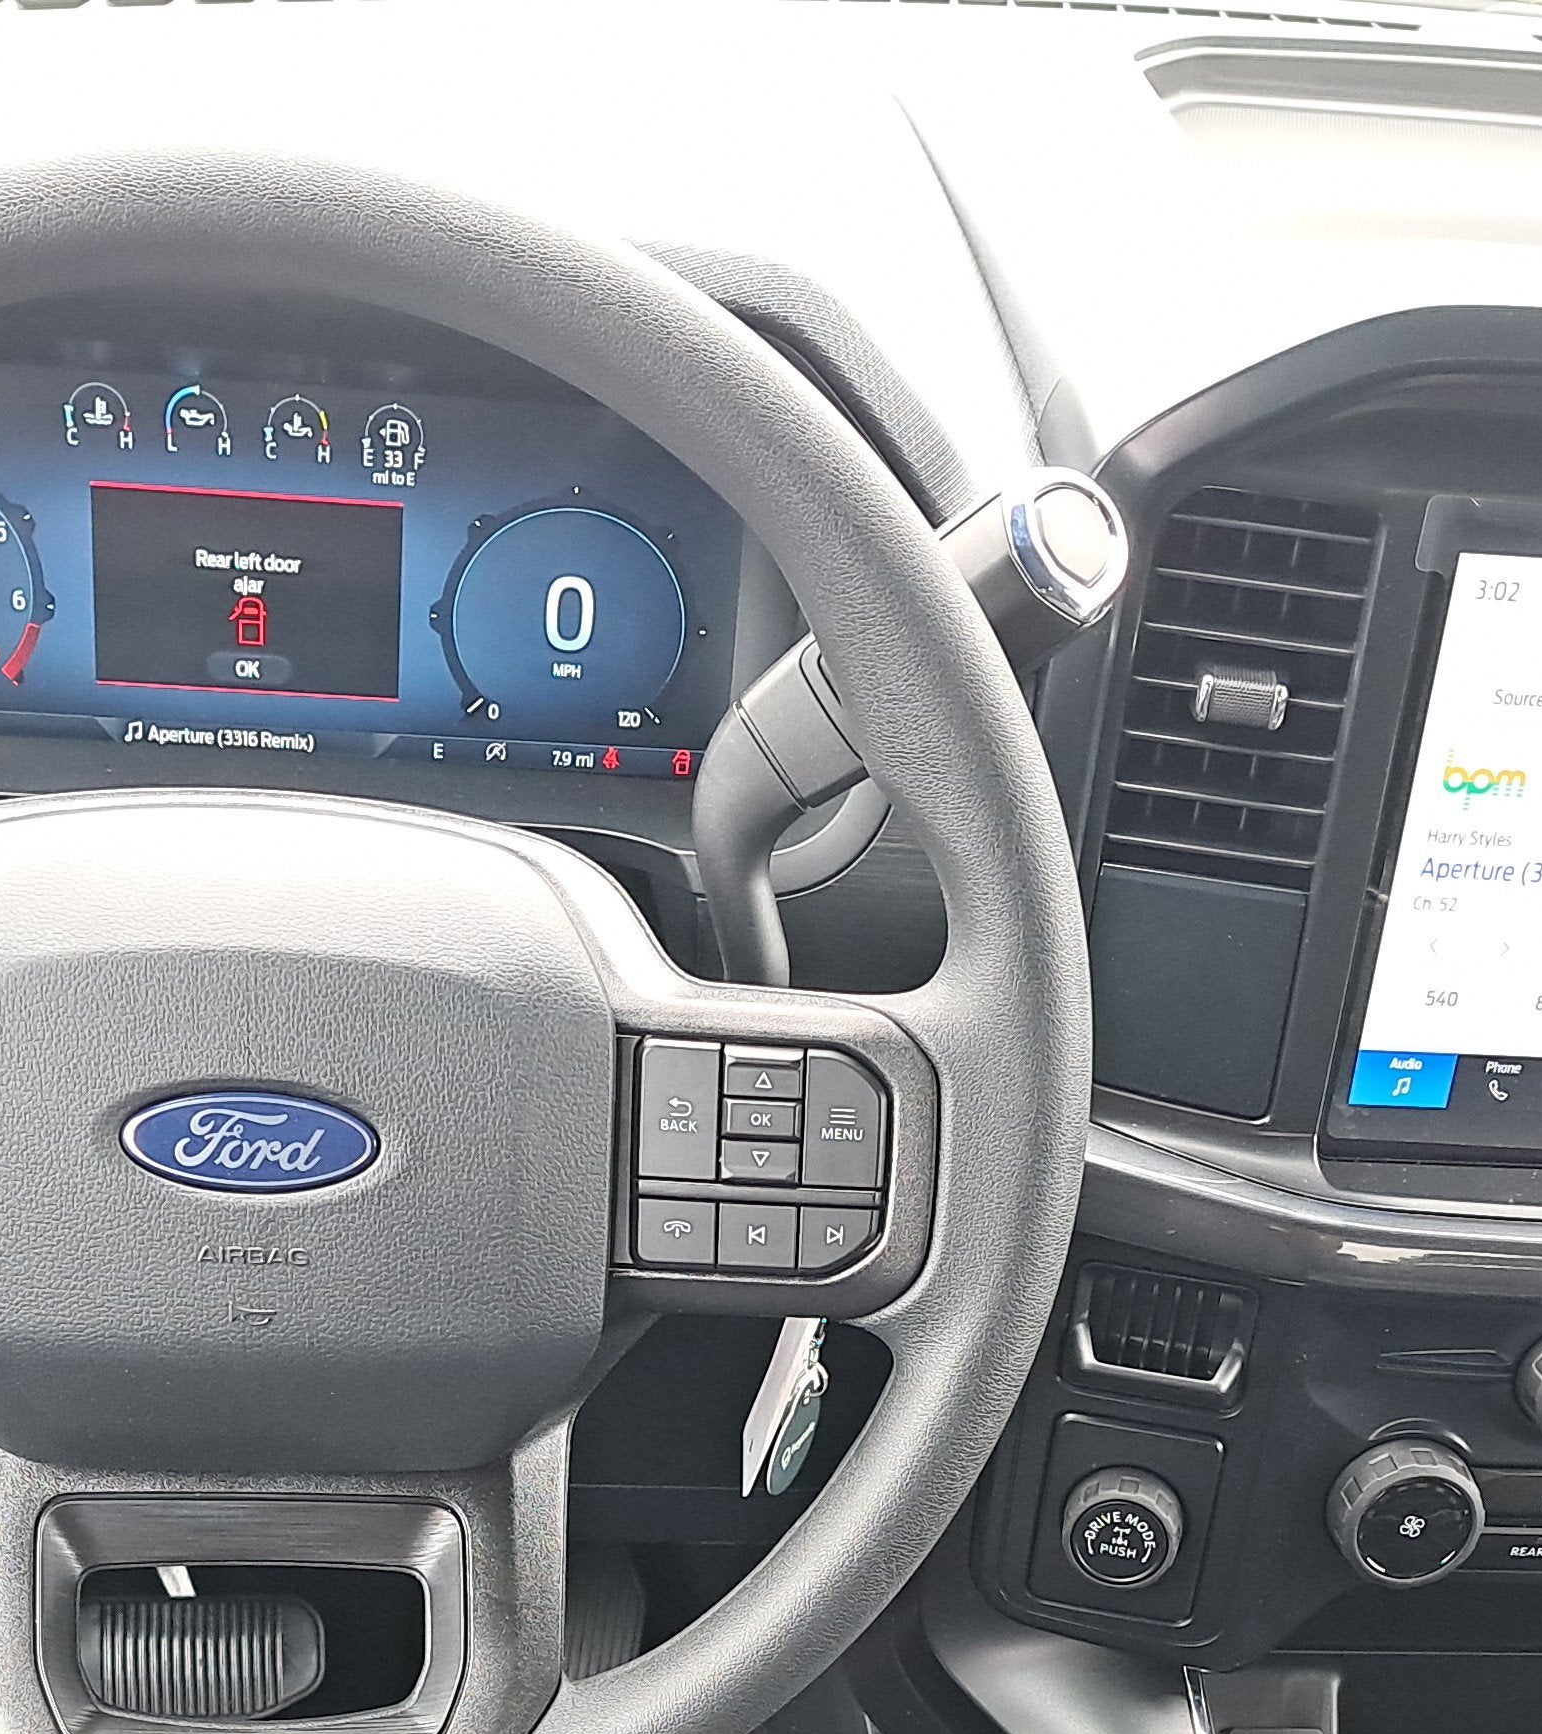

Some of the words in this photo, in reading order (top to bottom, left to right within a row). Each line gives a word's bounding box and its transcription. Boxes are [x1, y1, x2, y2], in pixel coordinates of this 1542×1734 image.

[66, 429, 79, 446] C
[119, 432, 133, 450] H
[167, 434, 178, 452] L
[217, 437, 231, 455] H
[265, 442, 277, 459] C
[317, 446, 332, 464] H
[363, 450, 374, 467] E
[384, 451, 404, 468] 33
[414, 452, 425, 470] F
[391, 472, 405, 486] to
[406, 473, 416, 487] E
[195, 550, 232, 569] Rear
[233, 552, 263, 572] left
[264, 555, 301, 574] door
[233, 576, 264, 595] ajar
[1475, 580, 1522, 603] 3:02
[12, 590, 26, 611] 6
[543, 575, 596, 653] 0
[235, 661, 261, 679] OK
[552, 663, 582, 680] MPH
[487, 703, 500, 721] 0
[617, 710, 641, 728] 120
[147, 727, 215, 747] Aperture
[217, 731, 258, 750] (3316
[260, 732, 315, 753] Remix)
[433, 743, 445, 760] E
[552, 750, 573, 768] 7.9
[575, 752, 594, 769] mi
[1427, 828, 1467, 847] Harry
[1470, 829, 1513, 848] Styles
[1419, 857, 1515, 885] Aperture
[1439, 897, 1458, 913] 52
[1425, 991, 1459, 1008] 540
[1389, 1057, 1423, 1071] Audio
[1485, 1061, 1524, 1076] Phone
[660, 1118, 698, 1133] BACK
[750, 1113, 772, 1127] OK
[174, 1107, 326, 1173] Ford
[820, 1127, 864, 1142] MENU
[196, 1244, 312, 1268] AIRBAG
[1084, 1510, 1122, 1541] DRIVE
[1124, 1513, 1157, 1549] MODE
[1099, 1543, 1138, 1559] PUSH
